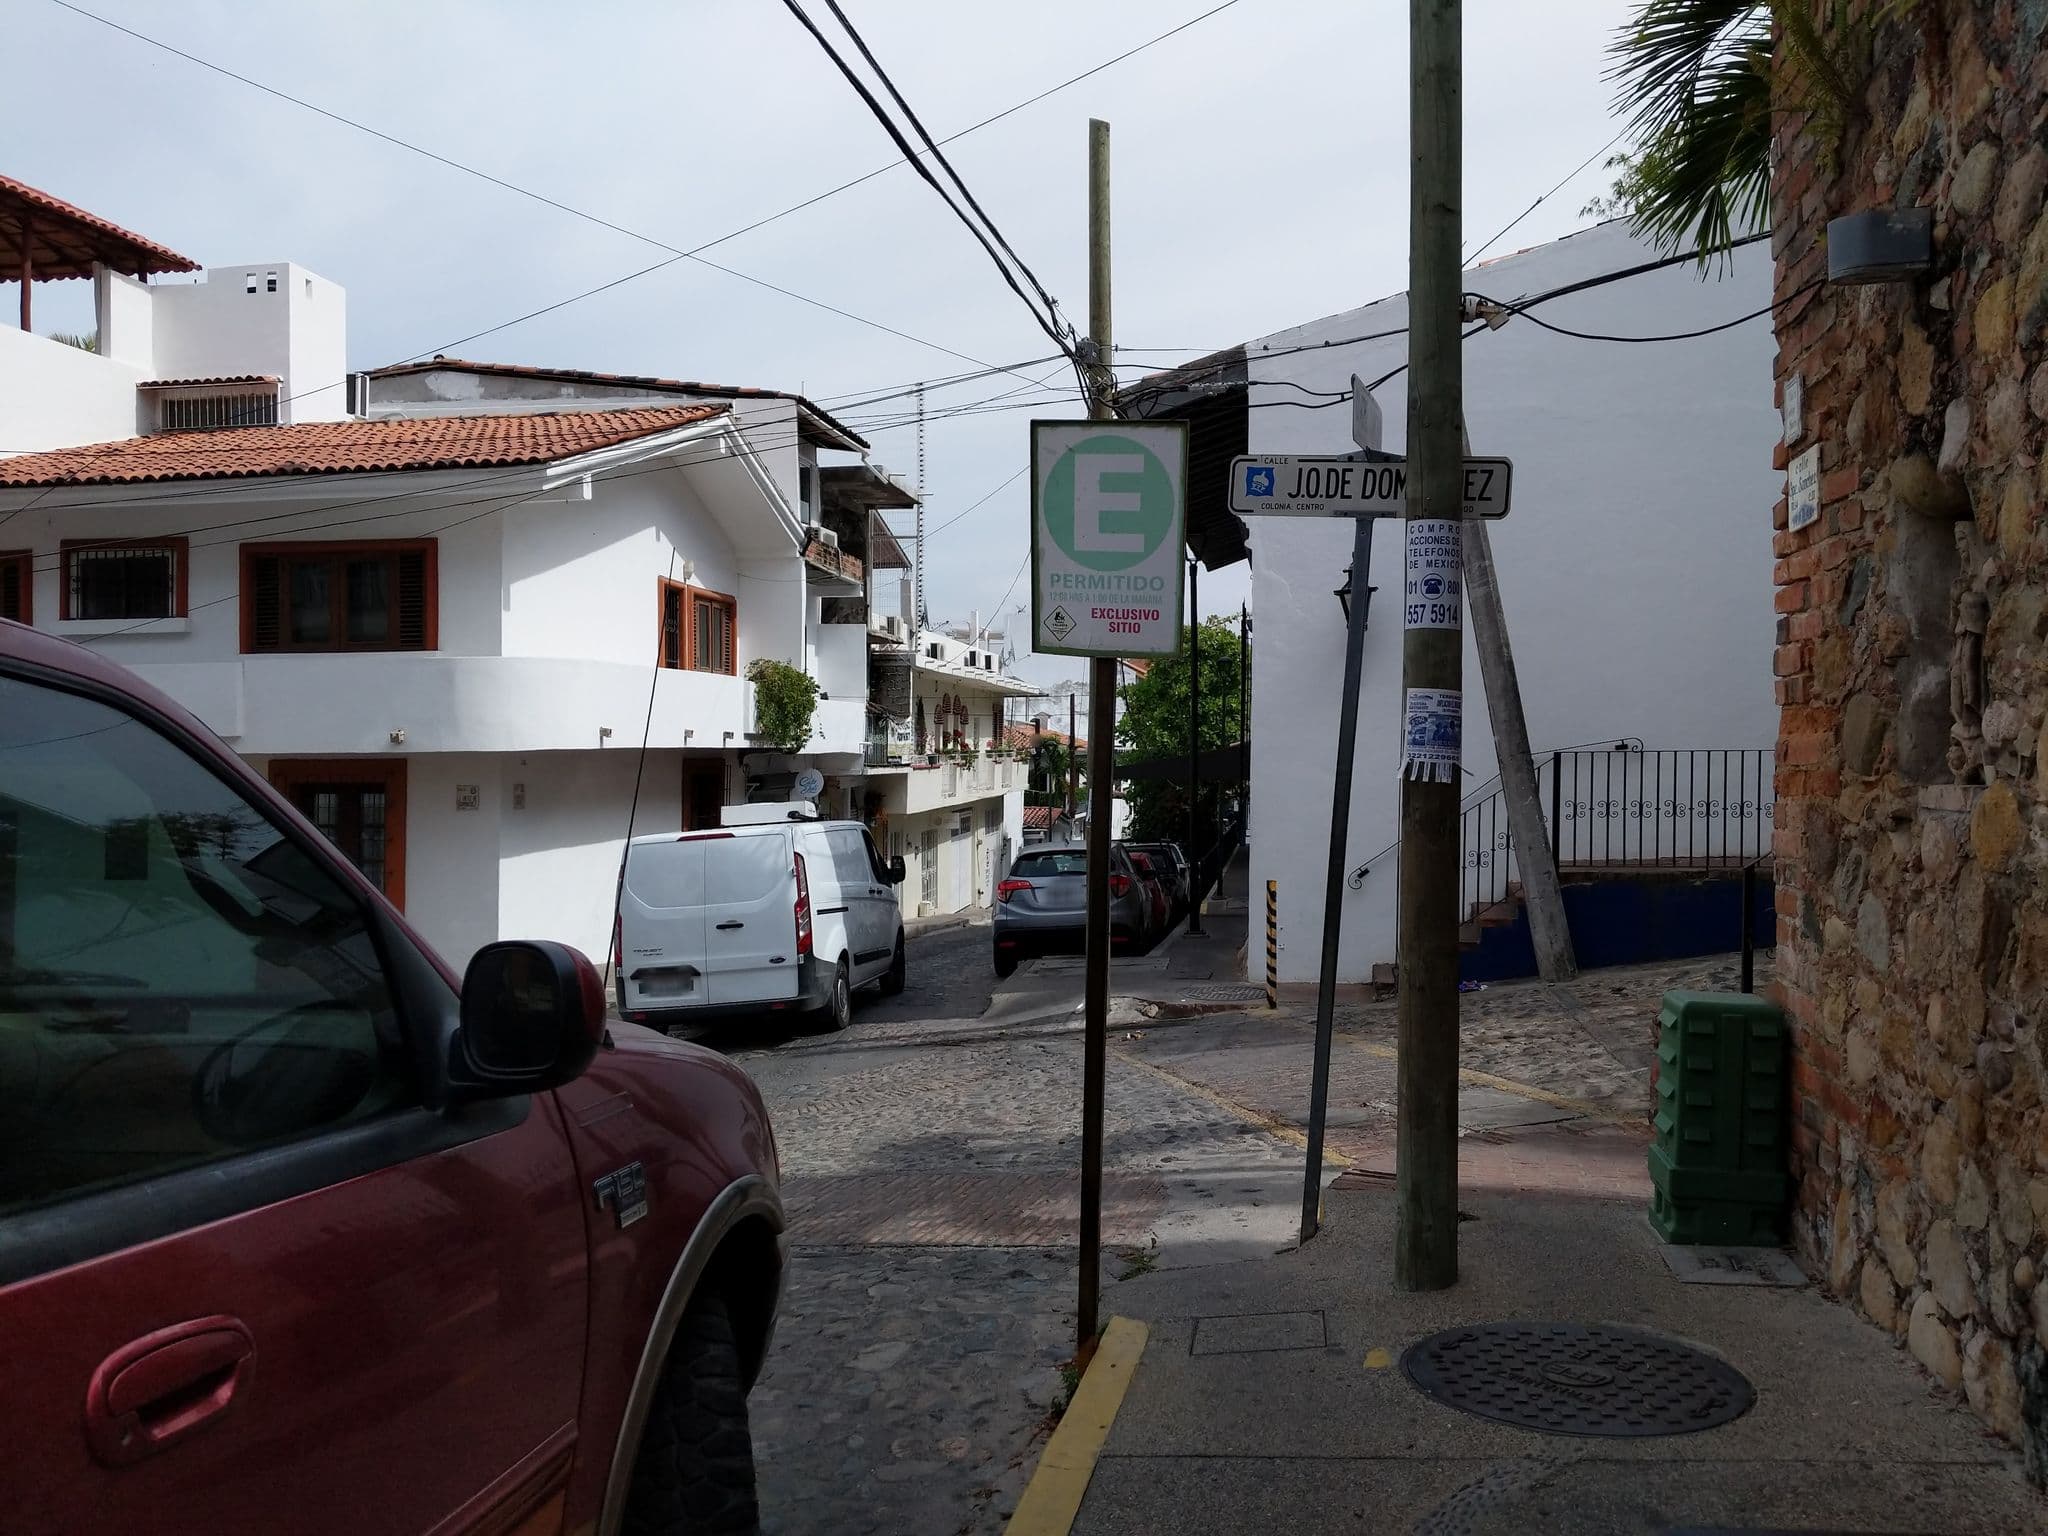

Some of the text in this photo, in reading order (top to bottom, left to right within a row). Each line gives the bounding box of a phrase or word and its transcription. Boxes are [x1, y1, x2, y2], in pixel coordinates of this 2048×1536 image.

[1264, 457, 1289, 465] CALLE
[1073, 454, 1145, 552] E
[1296, 503, 1325, 511] CENTRO
[1409, 524, 1460, 534] COMPRO
[1409, 536, 1460, 546] ACCIONES DE
[1409, 547, 1460, 558] TELEFONOS
[1409, 559, 1460, 569] DE MEXICO
[1050, 573, 1165, 591] PERMITIDO
[1408, 580, 1418, 594] 01
[1091, 607, 1160, 621] EXCLUSIVO
[1407, 603, 1458, 624] 557 5914
[1108, 621, 1141, 634] SITIO
